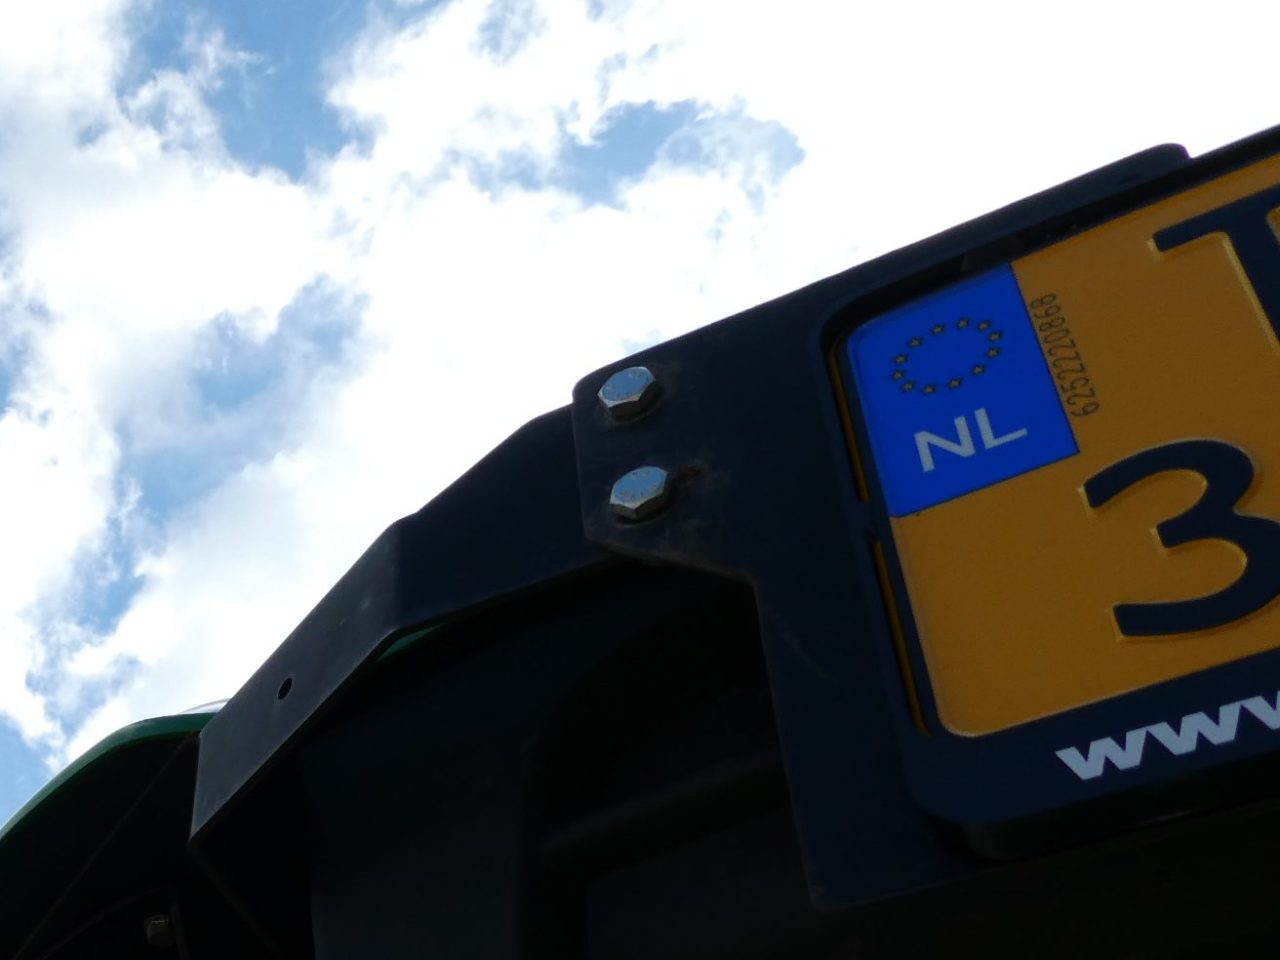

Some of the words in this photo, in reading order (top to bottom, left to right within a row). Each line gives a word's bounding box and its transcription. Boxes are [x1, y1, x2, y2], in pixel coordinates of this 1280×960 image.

[1029, 293, 1101, 417] 6252220868
[913, 407, 1028, 472] NL
[1083, 440, 1280, 637] 3
